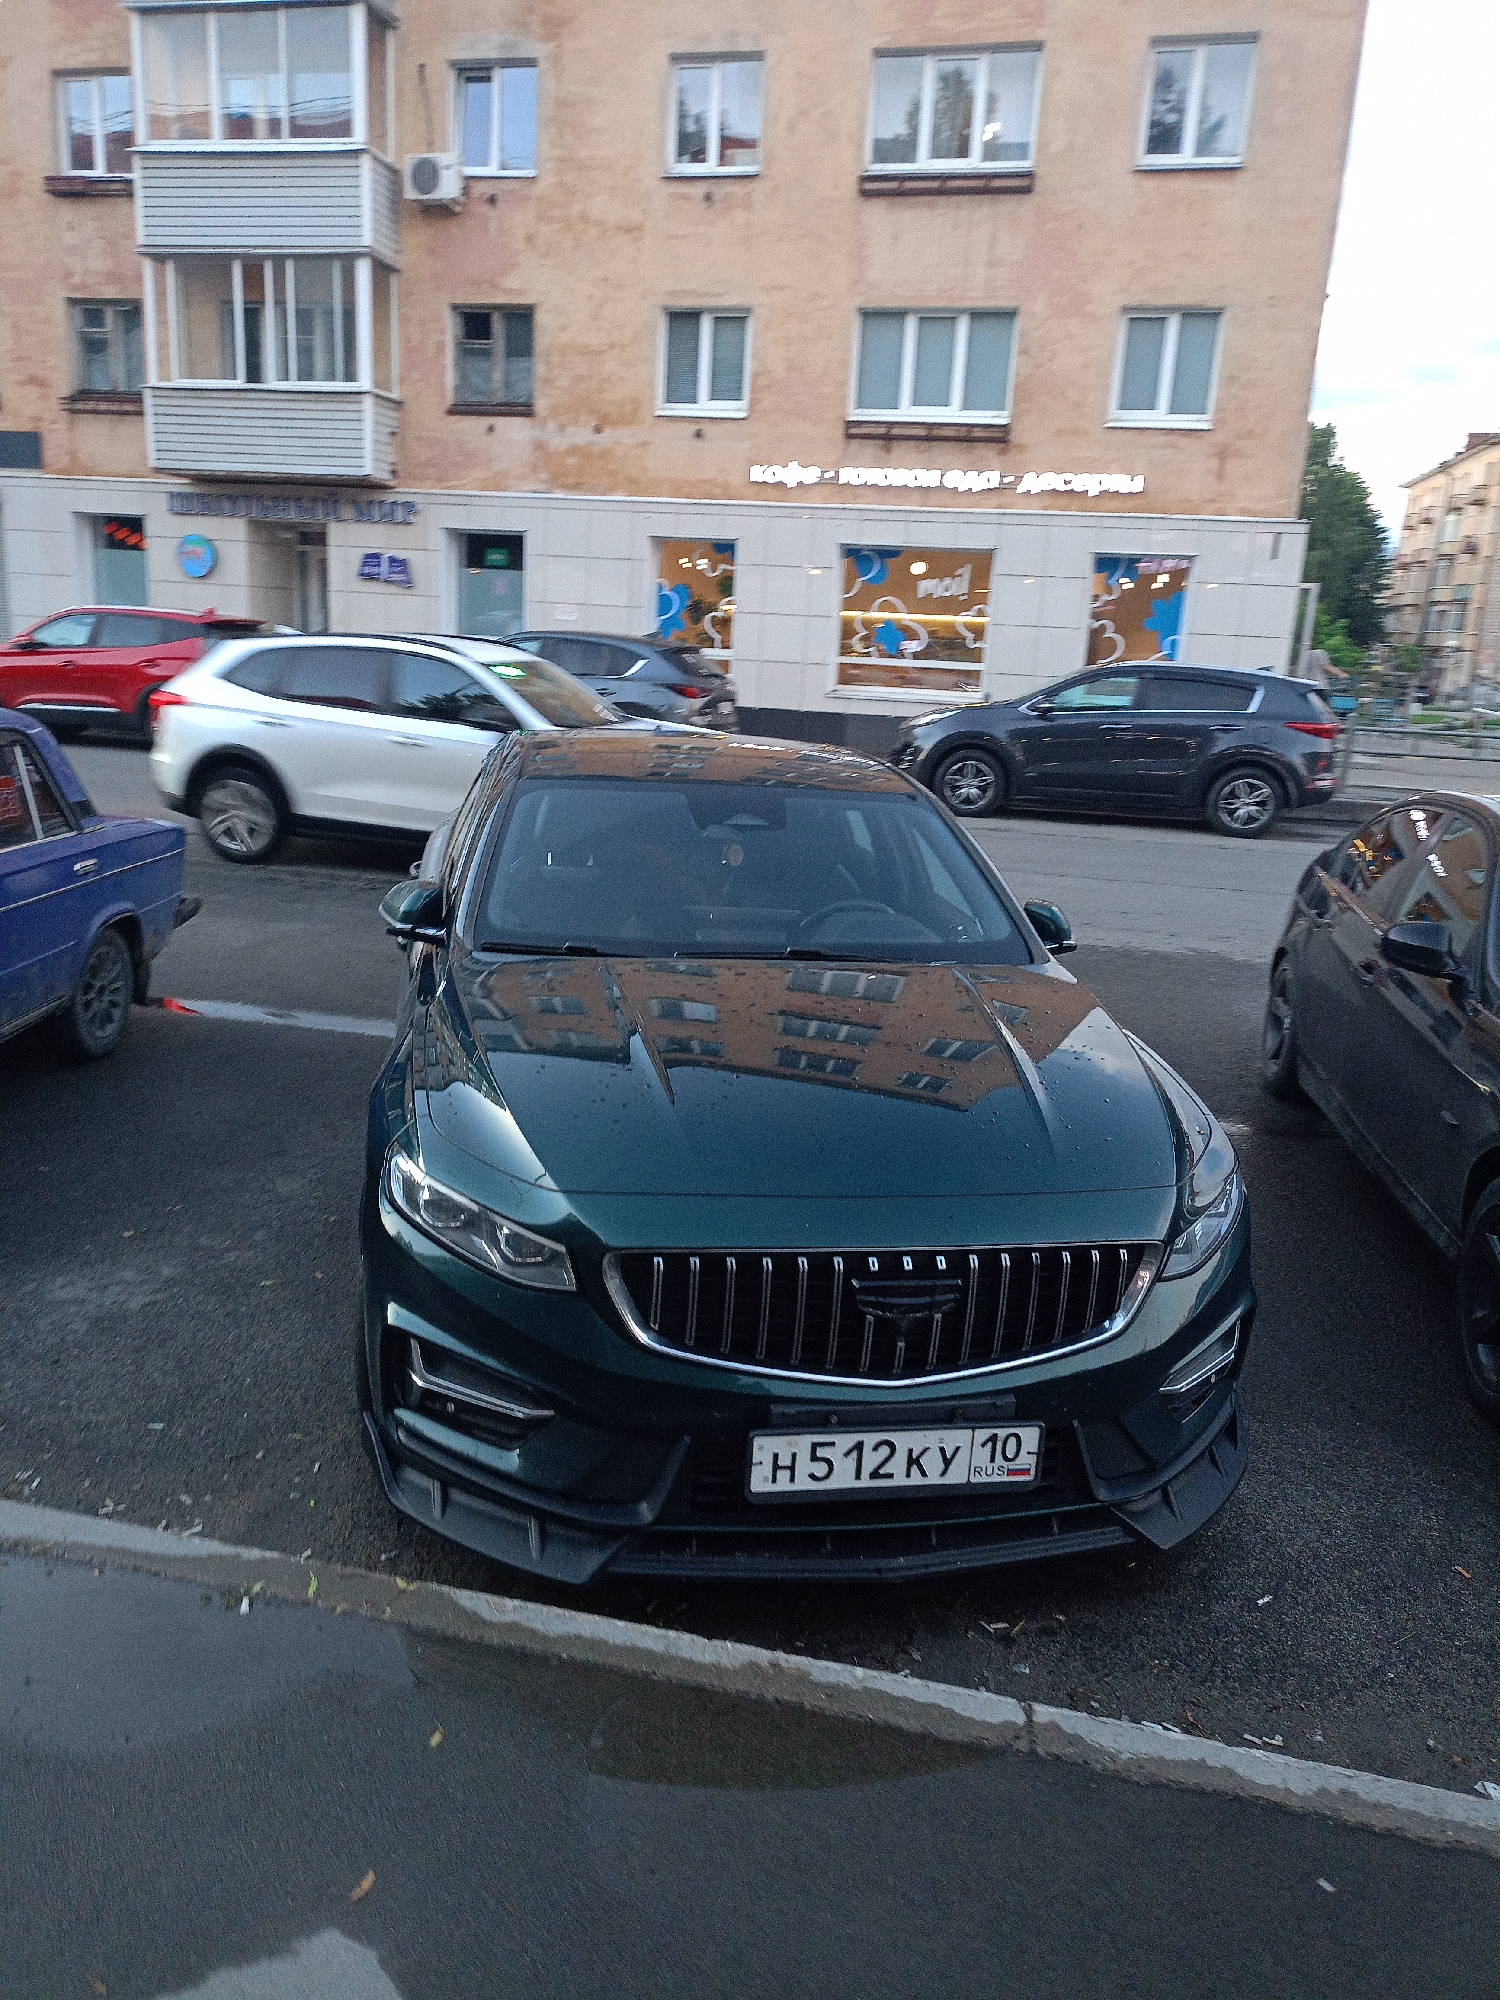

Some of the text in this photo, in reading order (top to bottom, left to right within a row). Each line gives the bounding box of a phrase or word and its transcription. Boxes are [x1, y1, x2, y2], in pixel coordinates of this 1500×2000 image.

[749, 460, 821, 488] кофе
[980, 1432, 1022, 1464] 10
[973, 1465, 1005, 1478] RUS
